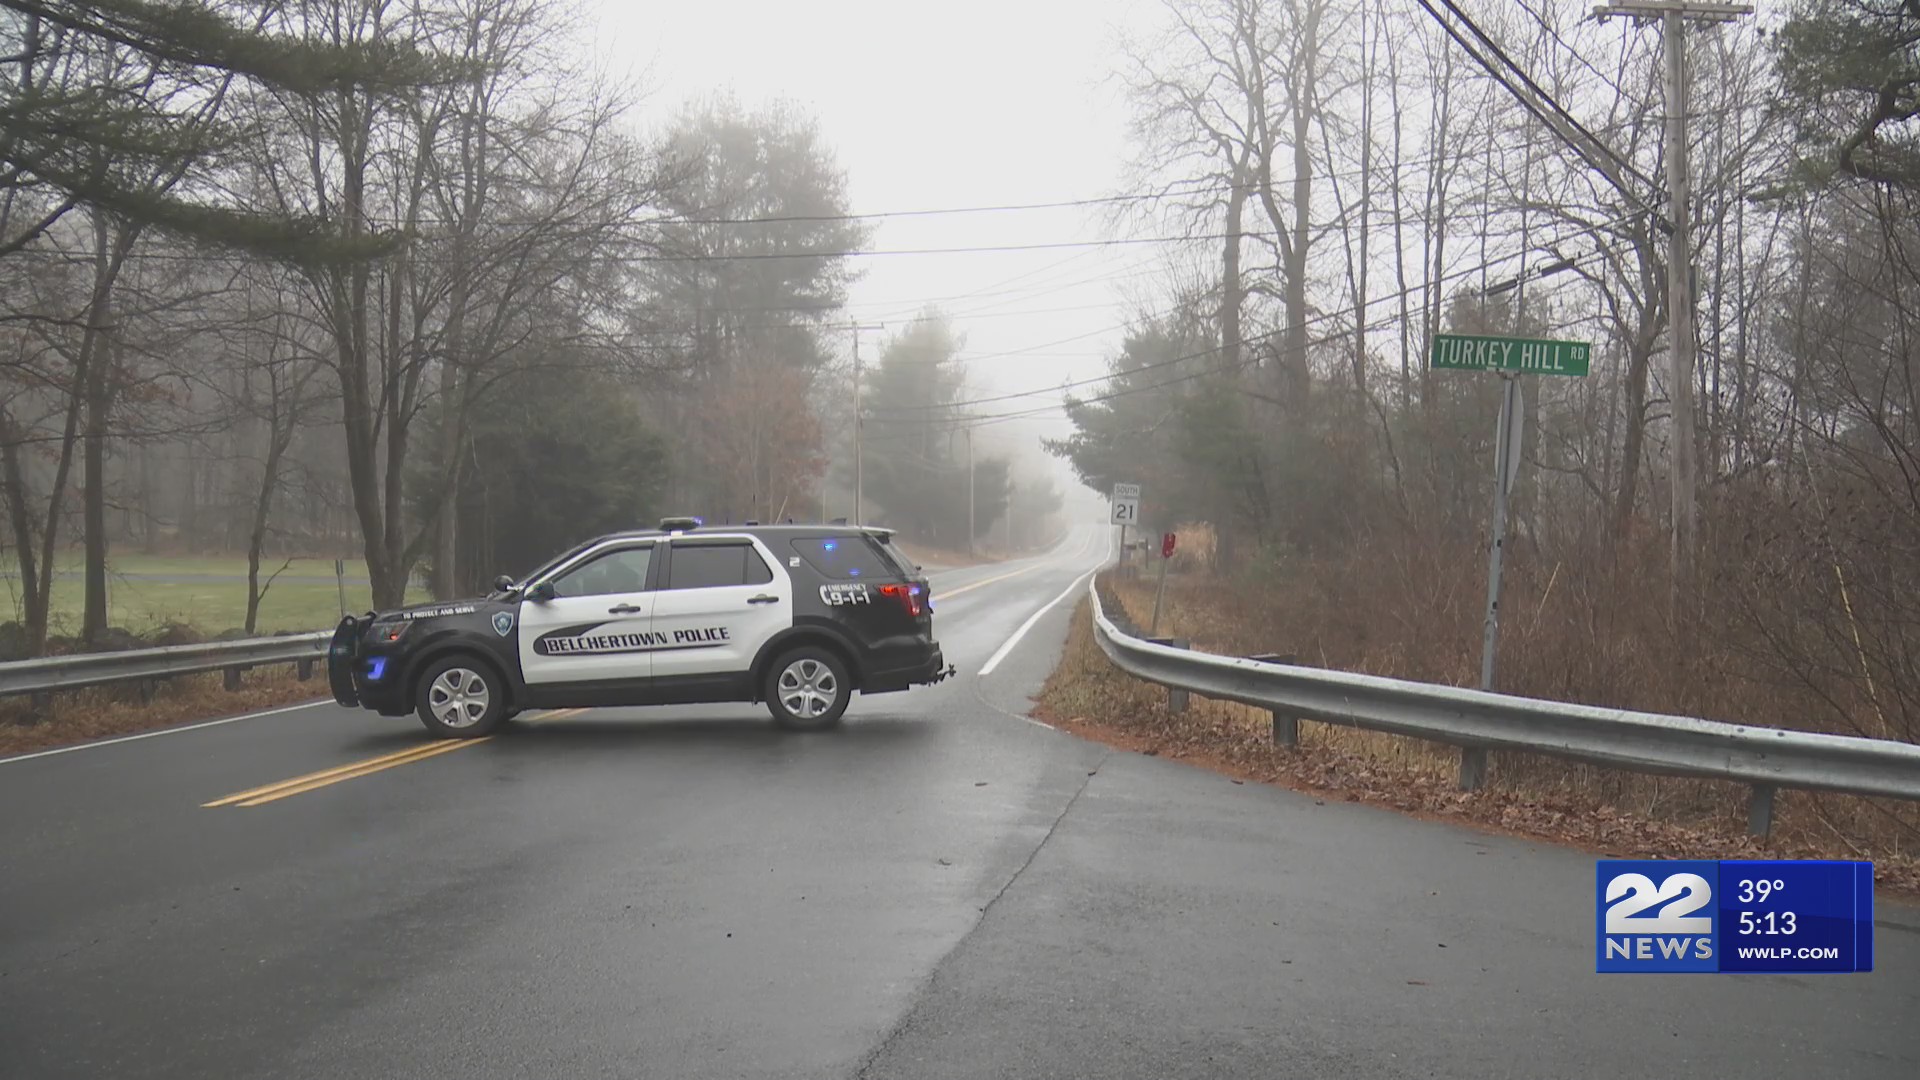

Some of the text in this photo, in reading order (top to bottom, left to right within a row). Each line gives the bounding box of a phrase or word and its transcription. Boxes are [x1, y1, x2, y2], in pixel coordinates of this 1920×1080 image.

[1439, 339, 1584, 370] TURKEY HILL RD
[1116, 486, 1138, 494] SOUTH
[1116, 504, 1133, 519] 21
[830, 592, 870, 605] 9-1-1
[413, 610, 438, 619] PROTECT
[440, 608, 454, 616] AND
[455, 606, 475, 614] SERVE
[549, 627, 730, 652] BELCHERTOWN POLICE
